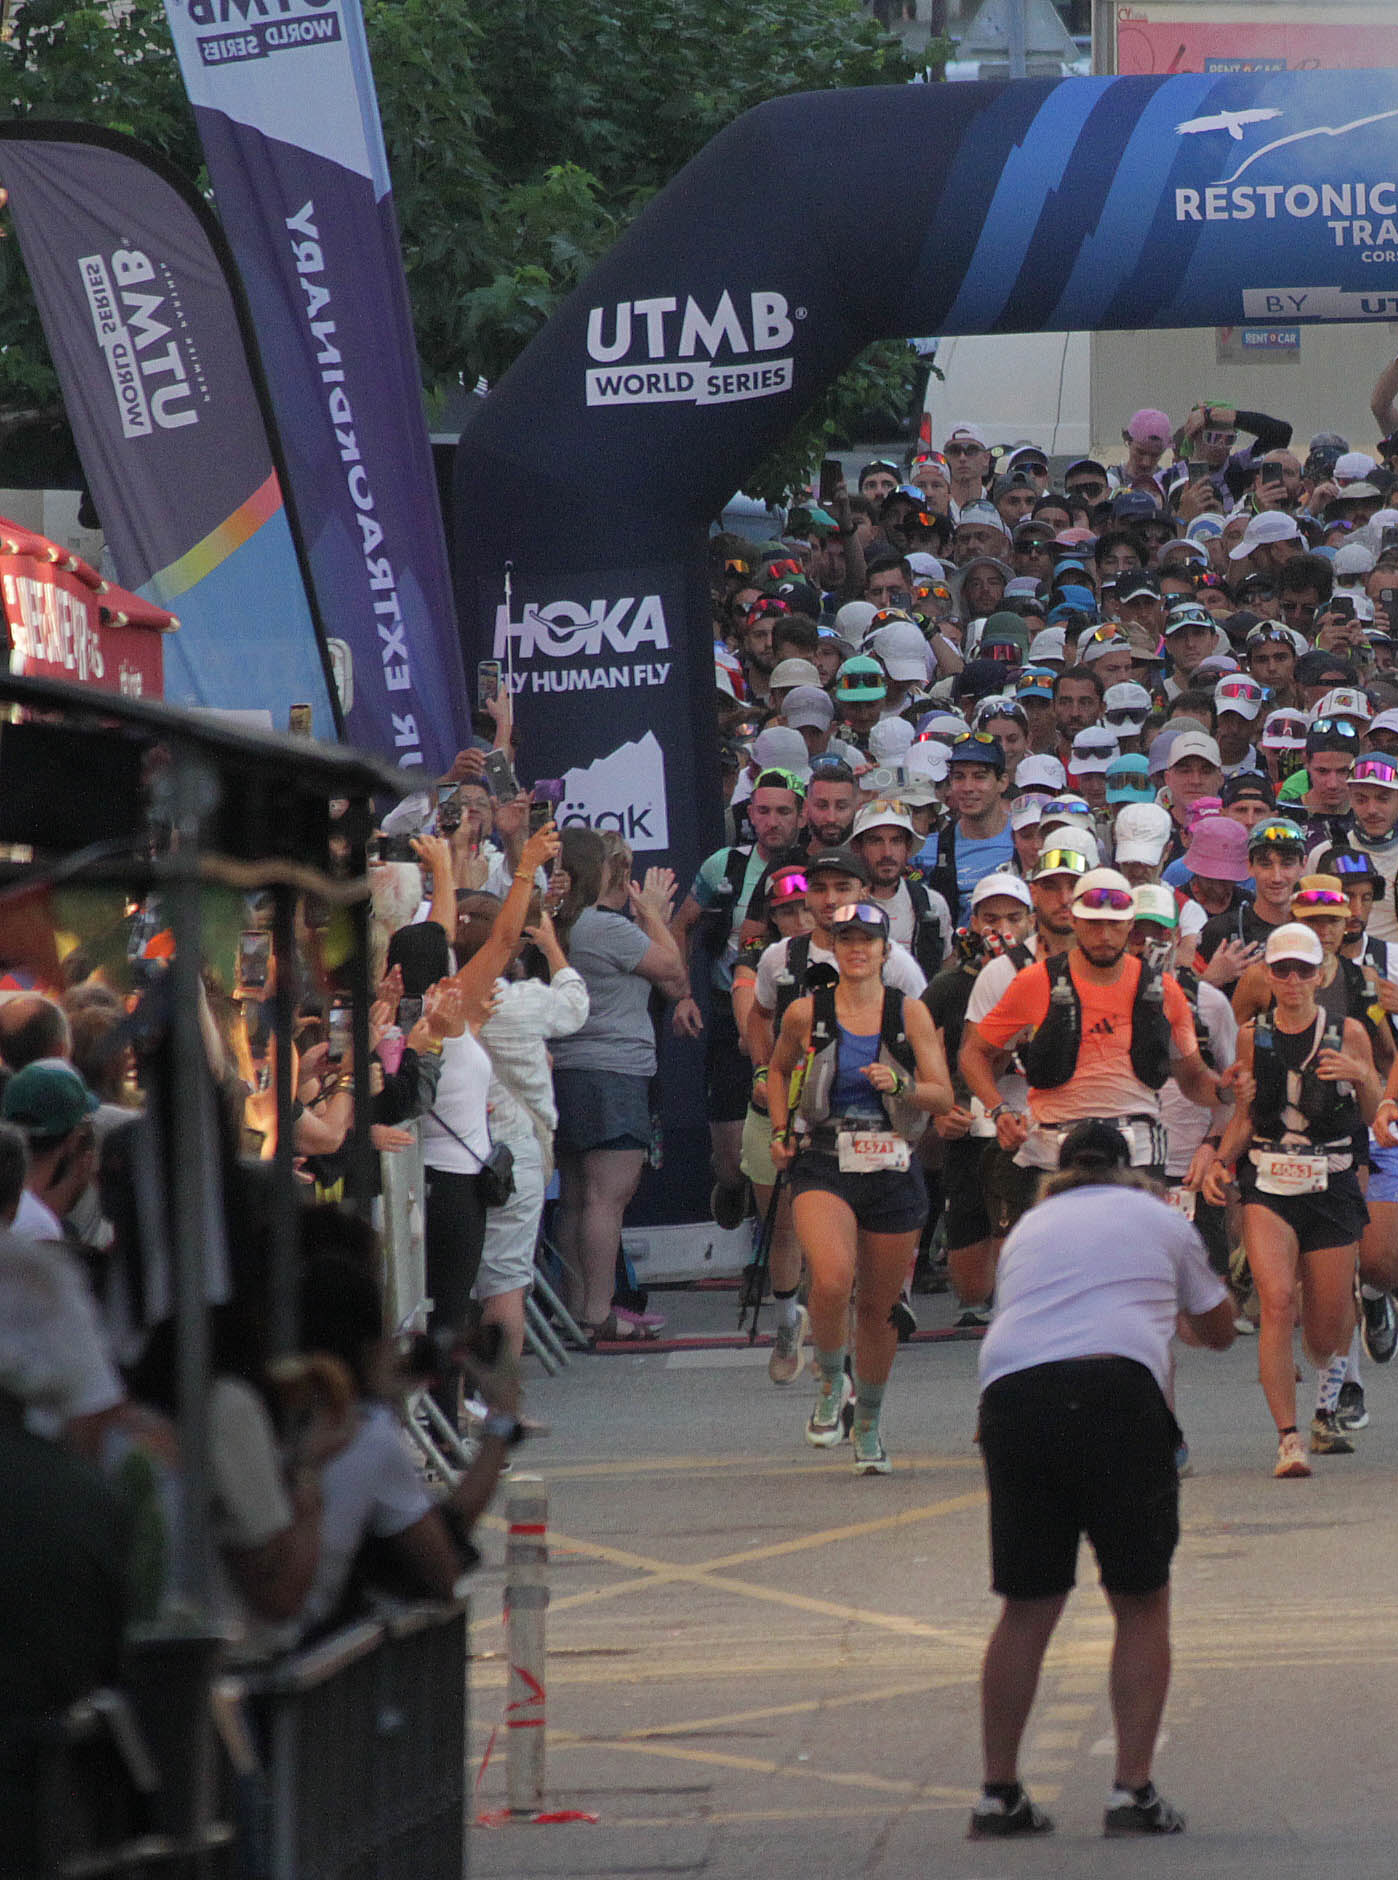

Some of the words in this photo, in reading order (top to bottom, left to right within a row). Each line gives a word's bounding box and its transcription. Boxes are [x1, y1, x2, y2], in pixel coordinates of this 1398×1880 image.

[1266, 294, 1309, 313] BY
[1278, 332, 1297, 345] CAR
[595, 371, 694, 396] WORLD
[707, 367, 785, 396] SERIES
[492, 595, 670, 659] HOKA
[531, 665, 630, 693] HUMAN
[634, 662, 673, 687] FLY
